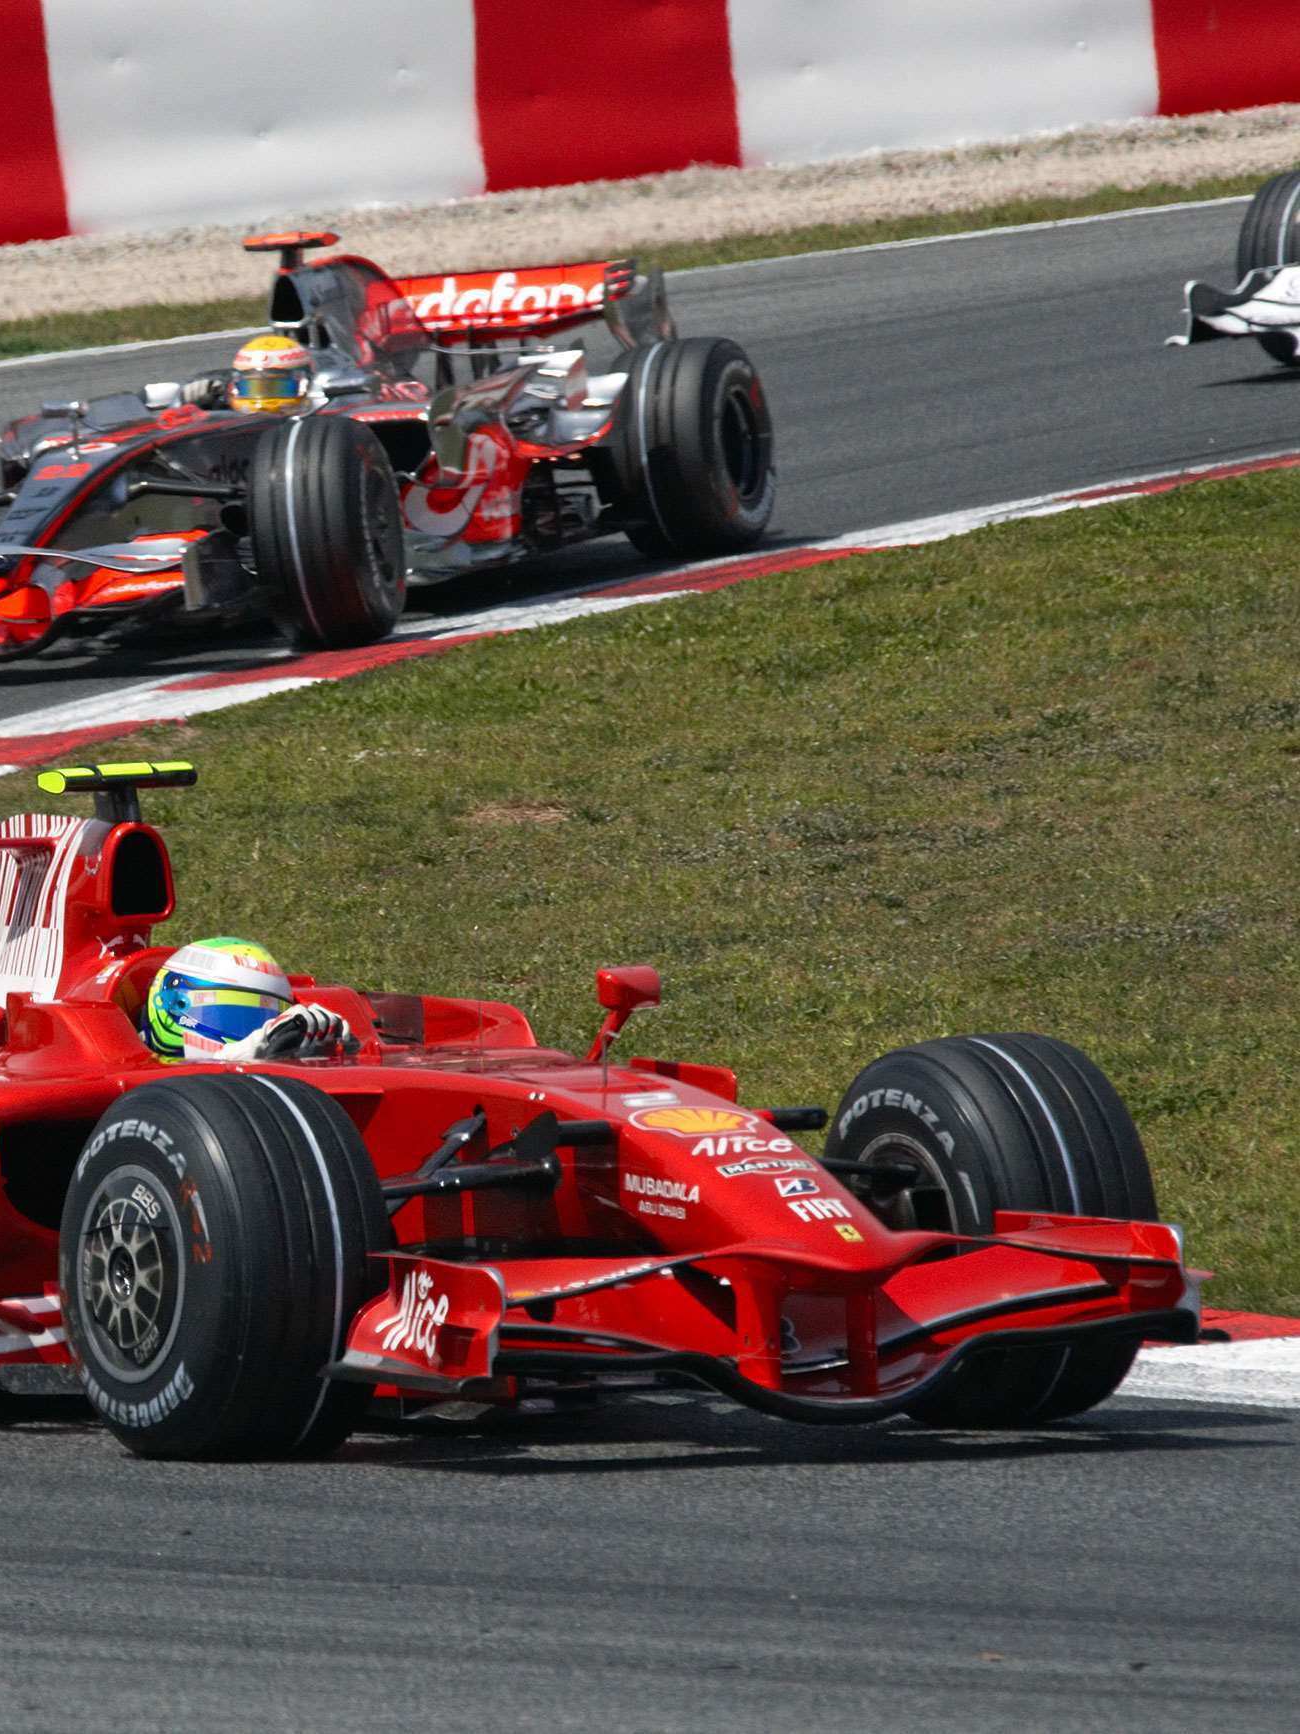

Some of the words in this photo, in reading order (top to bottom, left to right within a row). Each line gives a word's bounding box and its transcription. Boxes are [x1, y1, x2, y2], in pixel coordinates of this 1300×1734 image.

[838, 1088, 956, 1160] POTENZA
[77, 1119, 188, 1182] POTENZA
[131, 1183, 162, 1220] BBS
[624, 1172, 699, 1204] MUBADALA
[787, 1198, 852, 1222] FIAT
[374, 1264, 449, 1358] Alice
